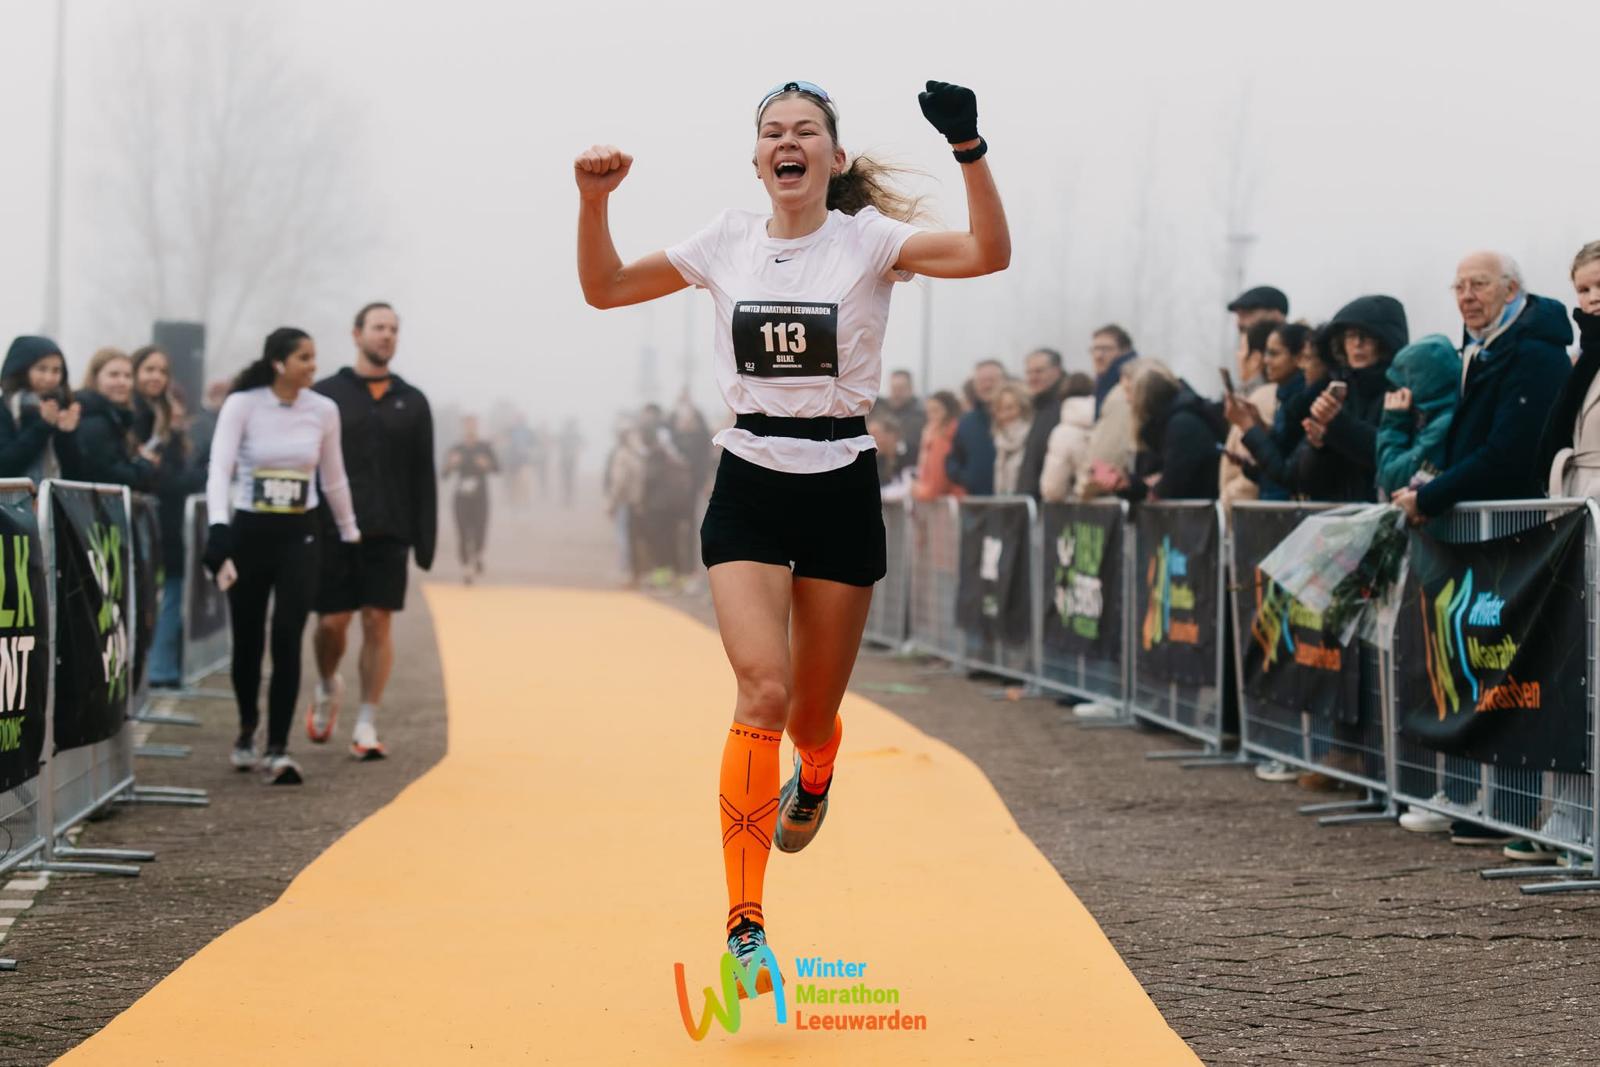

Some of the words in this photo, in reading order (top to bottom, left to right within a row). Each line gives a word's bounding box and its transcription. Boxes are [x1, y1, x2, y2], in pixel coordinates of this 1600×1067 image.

[740, 305, 760, 313] WINTER
[761, 305, 792, 314] MARATHON
[792, 306, 831, 315] LEEUWARDEN
[760, 322, 807, 353] 113
[776, 355, 795, 363] SILKE
[1469, 592, 1505, 626] Winter
